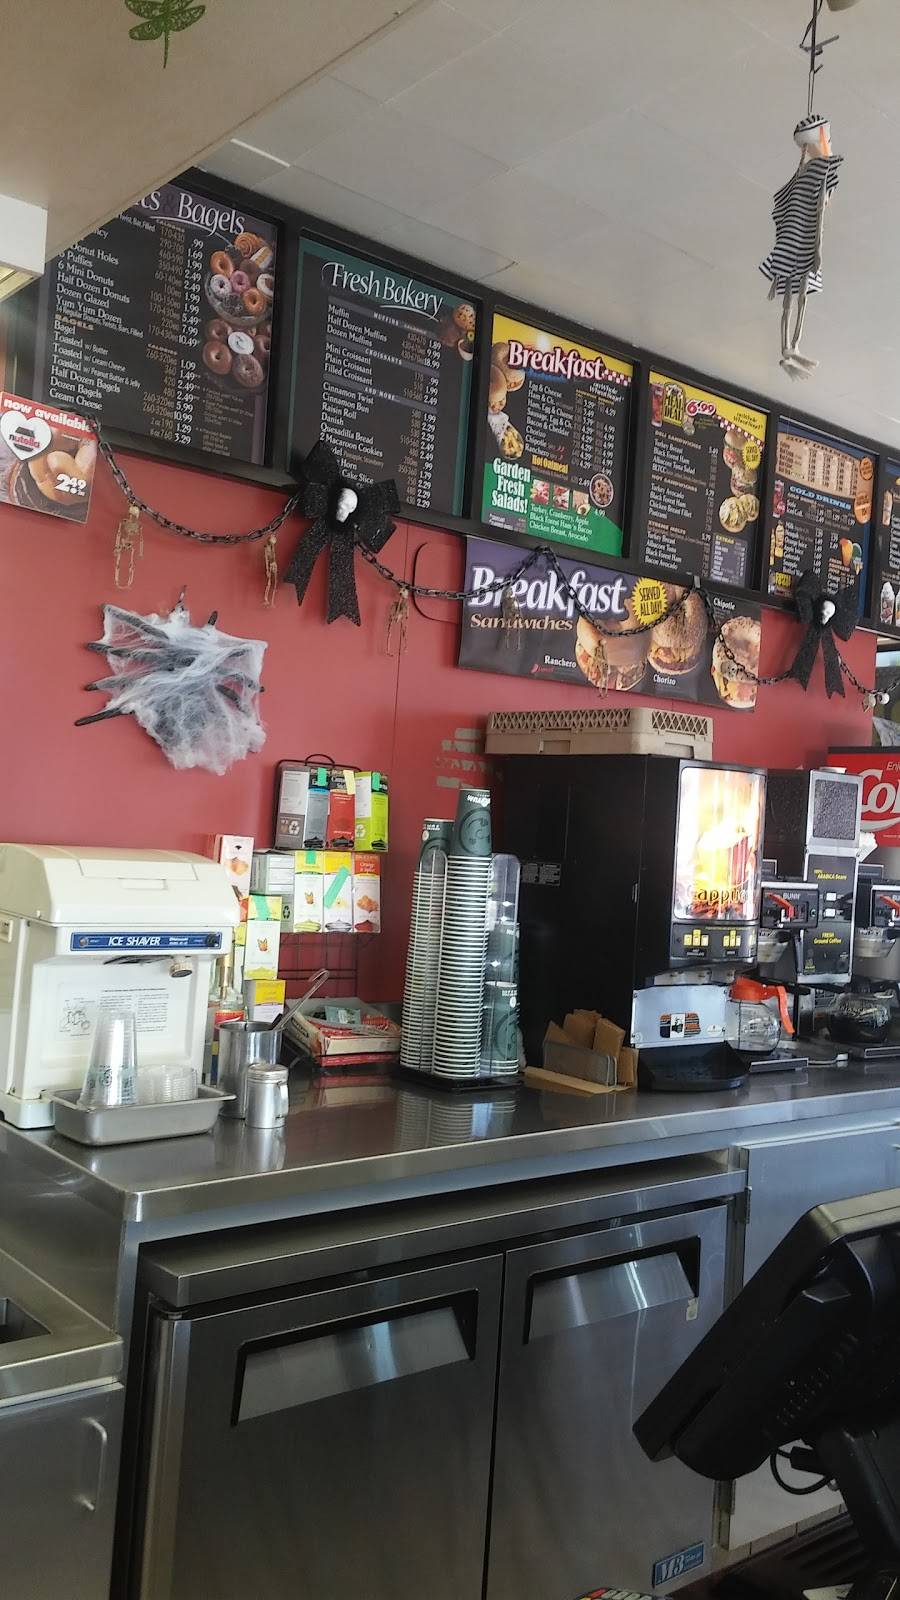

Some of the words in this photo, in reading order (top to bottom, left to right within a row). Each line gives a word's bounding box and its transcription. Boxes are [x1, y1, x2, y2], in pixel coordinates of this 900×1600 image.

[178, 193, 245, 236] Bagels
[188, 249, 203, 259] 1.69
[97, 248, 119, 265] Holes
[183, 280, 200, 292] 2.49
[187, 259, 202, 270] 1.99
[67, 250, 93, 268] Puffies
[185, 291, 200, 303] 1.99
[184, 269, 201, 281] 2.49
[57, 271, 74, 285] Half
[76, 278, 100, 294] Dozen
[102, 287, 130, 303] Donuts
[66, 262, 84, 277] Mini
[86, 269, 114, 287] Donuts
[184, 303, 200, 314] 1.99
[321, 262, 380, 298] Fresh
[382, 276, 443, 320] Bakery
[56, 294, 75, 309] Yum
[77, 301, 95, 315] Yum
[97, 308, 122, 324] Dozen
[56, 283, 81, 299] Dozen
[84, 292, 109, 308] Glazed
[182, 324, 198, 336] 7.99
[328, 304, 350, 319] Muffin
[55, 313, 94, 331] BAGELS
[373, 312, 399, 327] MUFFINS
[54, 331, 83, 348] Toasted
[327, 324, 348, 339] Dozen
[348, 332, 373, 347] Muffins
[328, 314, 341, 327] Half
[342, 319, 363, 334] Dozen
[363, 326, 388, 343] Muffins
[426, 348, 441, 360] 9.99
[53, 343, 82, 359] Toasted
[54, 320, 76, 335] Bagel
[181, 359, 196, 370] 1.09
[325, 342, 341, 355] Mini
[341, 347, 371, 365] Croissant
[52, 354, 82, 371] Toasted
[325, 353, 342, 366] Plain
[342, 357, 372, 376] Croissant
[365, 348, 402, 366] CROISSANTS
[508, 340, 603, 380] Breakfast
[324, 363, 343, 376] Filled
[343, 367, 373, 386] Croissant
[51, 365, 69, 378] Half
[69, 370, 95, 386] Dozen
[96, 378, 121, 393] Bagels
[176, 401, 193, 413] 5.99
[322, 382, 356, 400] Cinnamon
[357, 392, 374, 405] Twist
[544, 386, 562, 398] Cheese
[4, 399, 32, 414] now
[50, 376, 75, 391] Dozen
[77, 383, 102, 399] Bagels
[173, 411, 193, 422] 10.99
[322, 392, 356, 410] Cinnamon
[664, 394, 683, 409] MEAL
[49, 388, 74, 403] Cream
[76, 395, 103, 410] Cheese
[176, 423, 192, 434] 1.29
[321, 402, 343, 416] Raisin
[343, 409, 357, 420] Roll
[556, 408, 574, 420] Cheese
[664, 405, 682, 421] DEAL
[685, 400, 716, 416] 6.99
[321, 411, 344, 426] Danish
[526, 415, 543, 428] Bacon
[548, 423, 570, 437] Cheddar
[9, 433, 41, 449] nutella
[174, 433, 191, 445] 3.29
[320, 422, 355, 439] Quesadilla
[355, 432, 374, 445] Bread
[525, 434, 547, 447] Chipotle
[667, 434, 701, 450] SANDWICHES
[325, 433, 357, 450] Macaroon
[358, 443, 383, 457] Cookies
[525, 443, 550, 457] Ranchero
[654, 439, 669, 449] Turkey
[669, 443, 683, 454] Breast
[340, 458, 358, 471] Horn
[531, 454, 542, 467] Hot
[542, 457, 569, 474] Oatmeal
[653, 447, 666, 456] Black
[666, 450, 679, 461] Forest
[680, 454, 690, 465] Ham
[493, 458, 531, 483] Garden
[653, 455, 672, 467] Albacore
[672, 460, 684, 471] Tuna
[684, 464, 696, 475] Salad
[342, 470, 358, 482] Cake
[497, 475, 525, 497] Fresh
[651, 483, 665, 493] Turkey
[666, 488, 685, 499] Avocado
[663, 478, 698, 493] SANDWICHES
[491, 490, 528, 514] Salads!
[650, 491, 662, 501] Black
[662, 495, 676, 506] Forest
[676, 498, 687, 508] Ham
[789, 485, 815, 498] COLD
[815, 494, 852, 511] DRINKS
[649, 500, 667, 511] Chicken
[667, 505, 681, 515] Breast
[530, 512, 544, 522] Black
[529, 520, 550, 533] Chicken
[568, 530, 589, 541] Avocado
[716, 534, 735, 544] EXTRAS
[646, 539, 666, 550] Albacore
[666, 543, 677, 553] Tuna
[645, 547, 659, 556] Black
[658, 550, 672, 561] Forest
[671, 553, 682, 563] Ham
[645, 555, 659, 565] Bacon
[659, 559, 678, 570] Avocado
[467, 566, 628, 618] Breakfast
[639, 586, 660, 602] SERVED
[640, 602, 650, 616] ALL
[650, 600, 662, 614] DAY!
[713, 597, 736, 610] Chipotle
[544, 655, 577, 669] Ranchero
[886, 762, 900, 771] Enj
[108, 936, 123, 946] ICE
[126, 936, 161, 946] SHAVER
